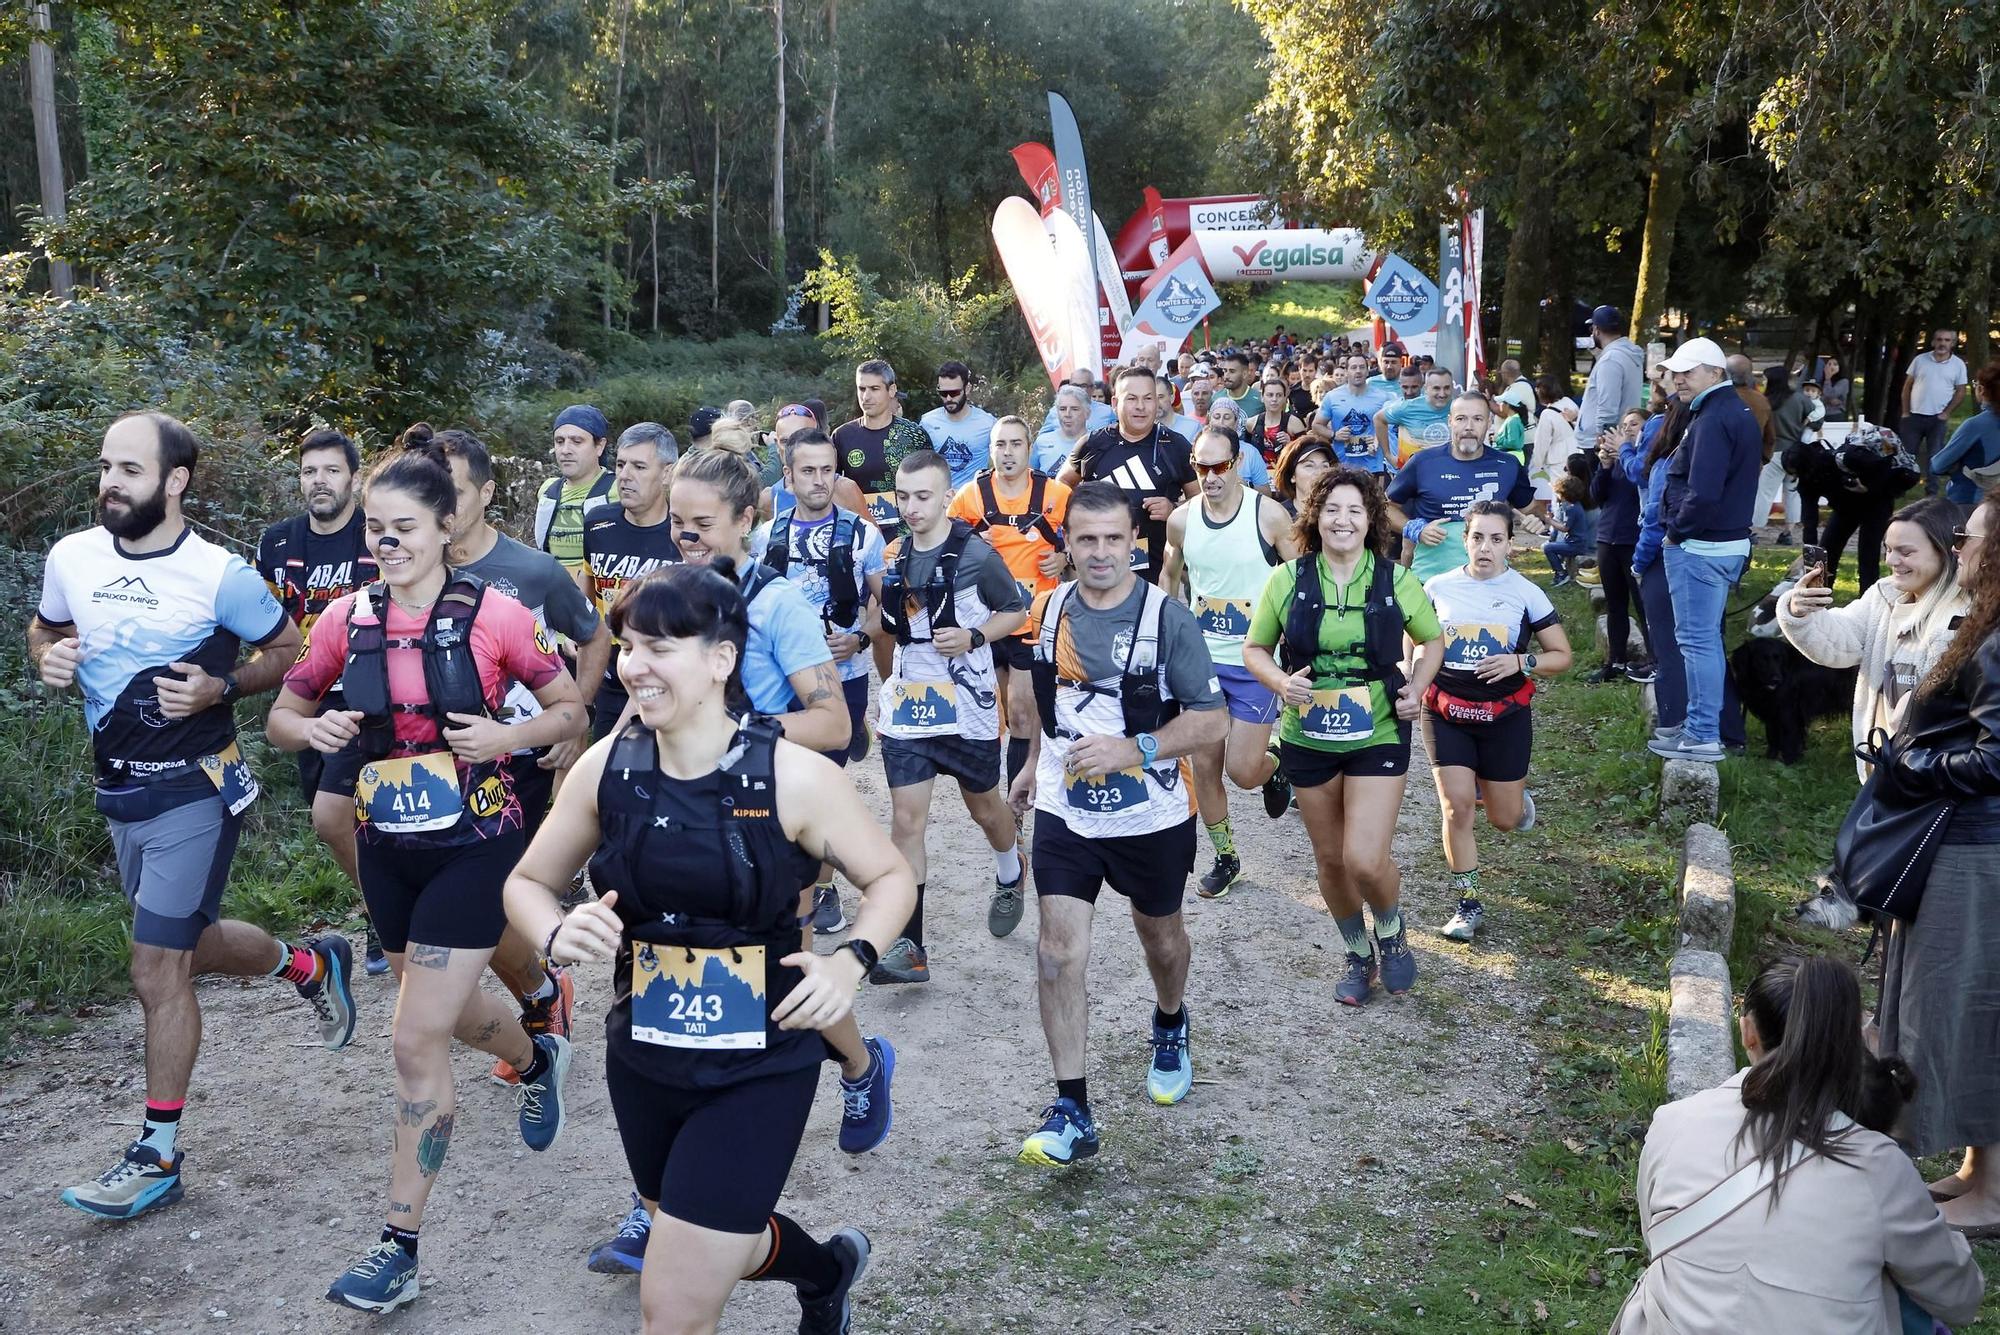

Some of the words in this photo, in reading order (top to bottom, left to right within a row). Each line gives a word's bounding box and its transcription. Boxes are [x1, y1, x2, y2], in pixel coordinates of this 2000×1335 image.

[1232, 239, 1344, 273] Vegalsa
[1156, 298, 1181, 307] MONTES
[1191, 297, 1206, 305] VIGO
[92, 591, 128, 602] BAIXO
[1211, 616, 1233, 630] 231
[1461, 644, 1489, 658] 469
[911, 705, 937, 720] 324
[1320, 712, 1352, 728] 422
[392, 789, 432, 813] 414
[1086, 787, 1123, 805] 323
[399, 813, 430, 824] Morgan
[733, 808, 770, 818] KIPRUN
[668, 992, 724, 1022] 243
[683, 1022, 707, 1034] TATI
